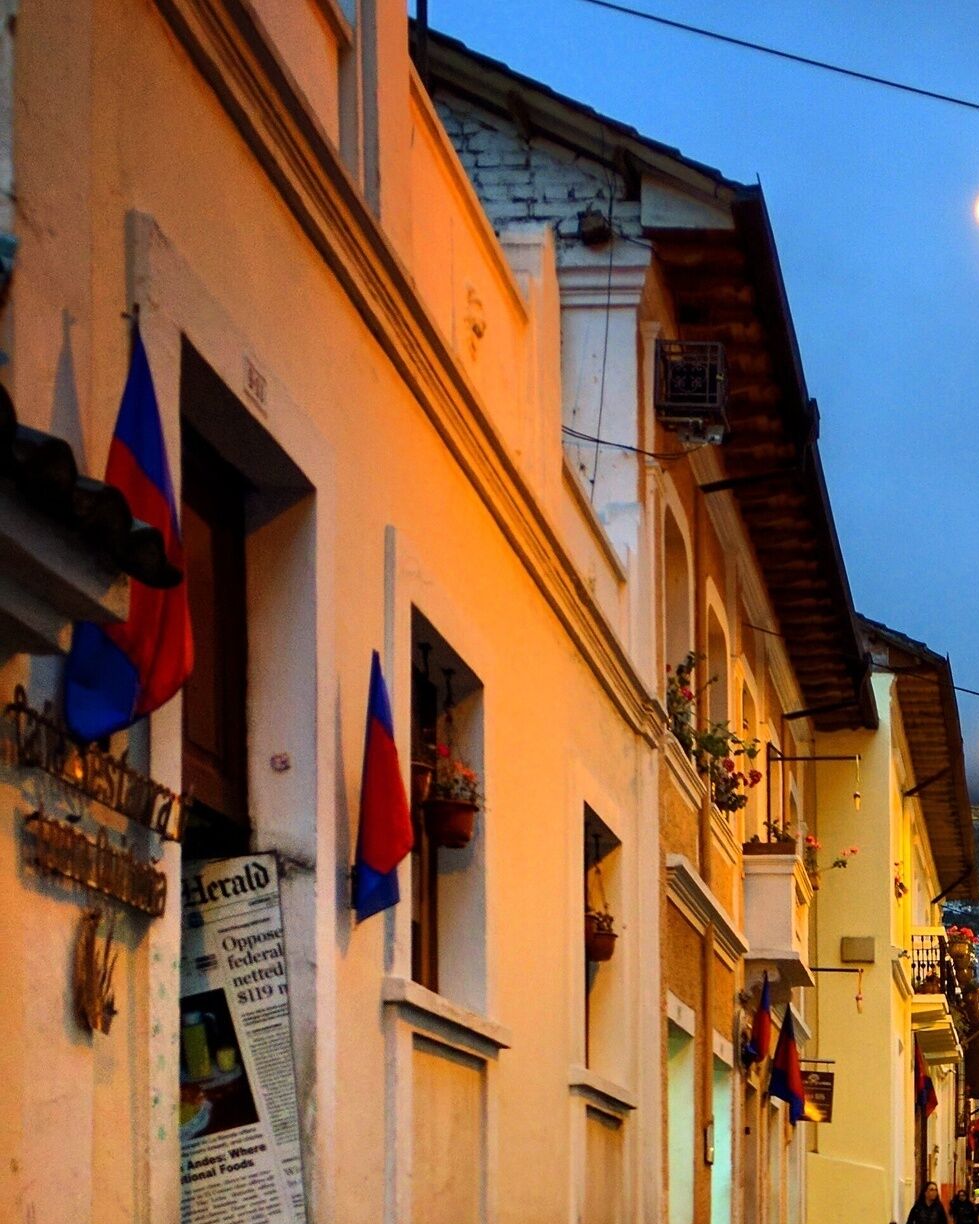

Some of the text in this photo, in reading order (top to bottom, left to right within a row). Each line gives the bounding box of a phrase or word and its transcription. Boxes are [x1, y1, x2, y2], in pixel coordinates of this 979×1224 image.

[232, 961, 284, 988] netted
[227, 1143, 267, 1159] Where
[219, 1160, 255, 1174] Foods
